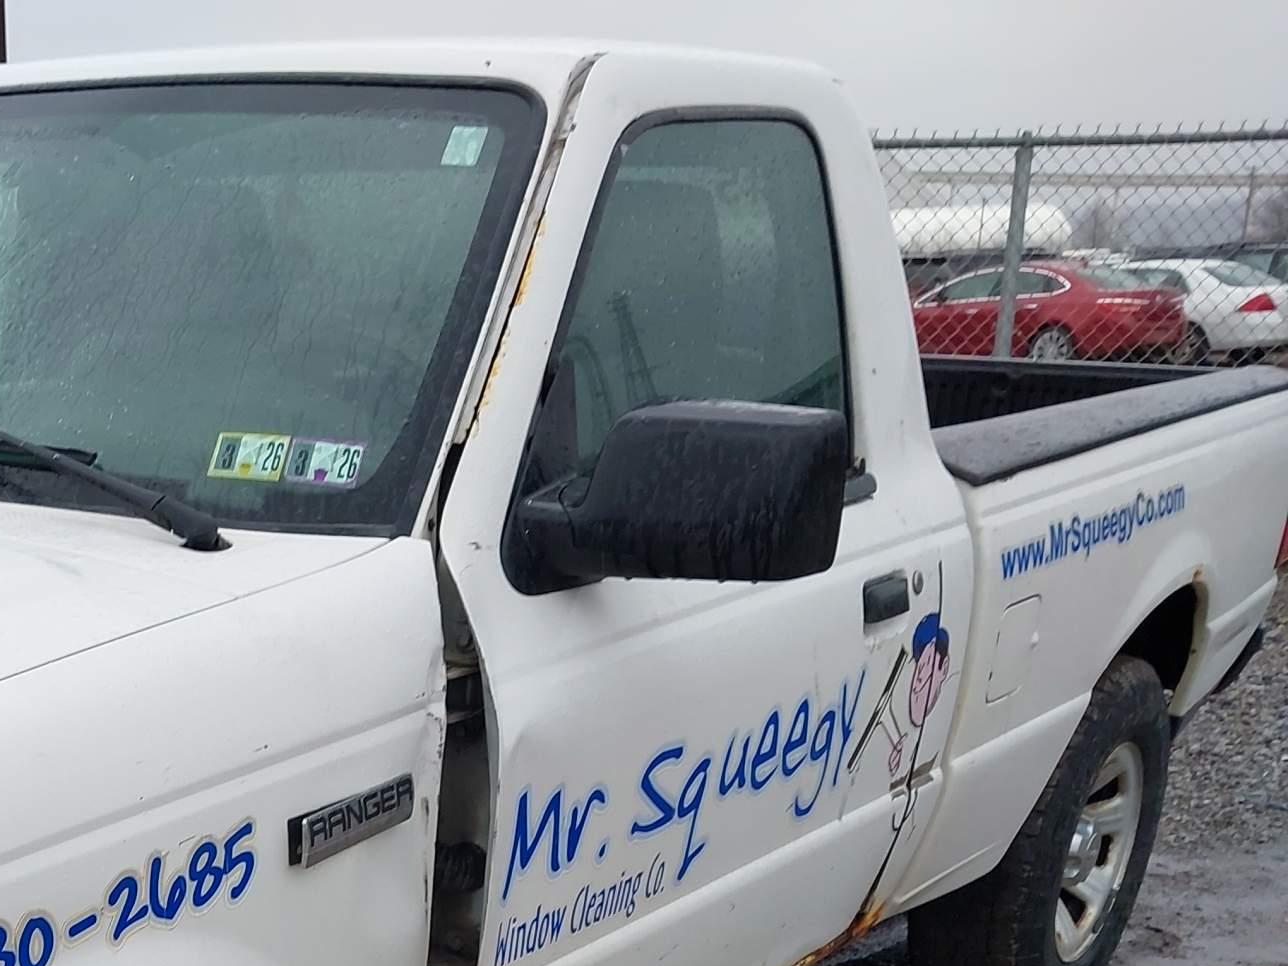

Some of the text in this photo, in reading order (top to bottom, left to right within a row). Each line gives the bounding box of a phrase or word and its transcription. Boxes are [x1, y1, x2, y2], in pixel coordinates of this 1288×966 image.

[222, 441, 285, 472] 3 26
[295, 448, 361, 479] 3 26
[1000, 484, 1185, 580] www.MrSqueegyCo.com
[309, 777, 413, 847] RANGER
[503, 669, 867, 901] Mr. Squeegy
[569, 870, 644, 935] Cleaning
[645, 852, 666, 898] Co.
